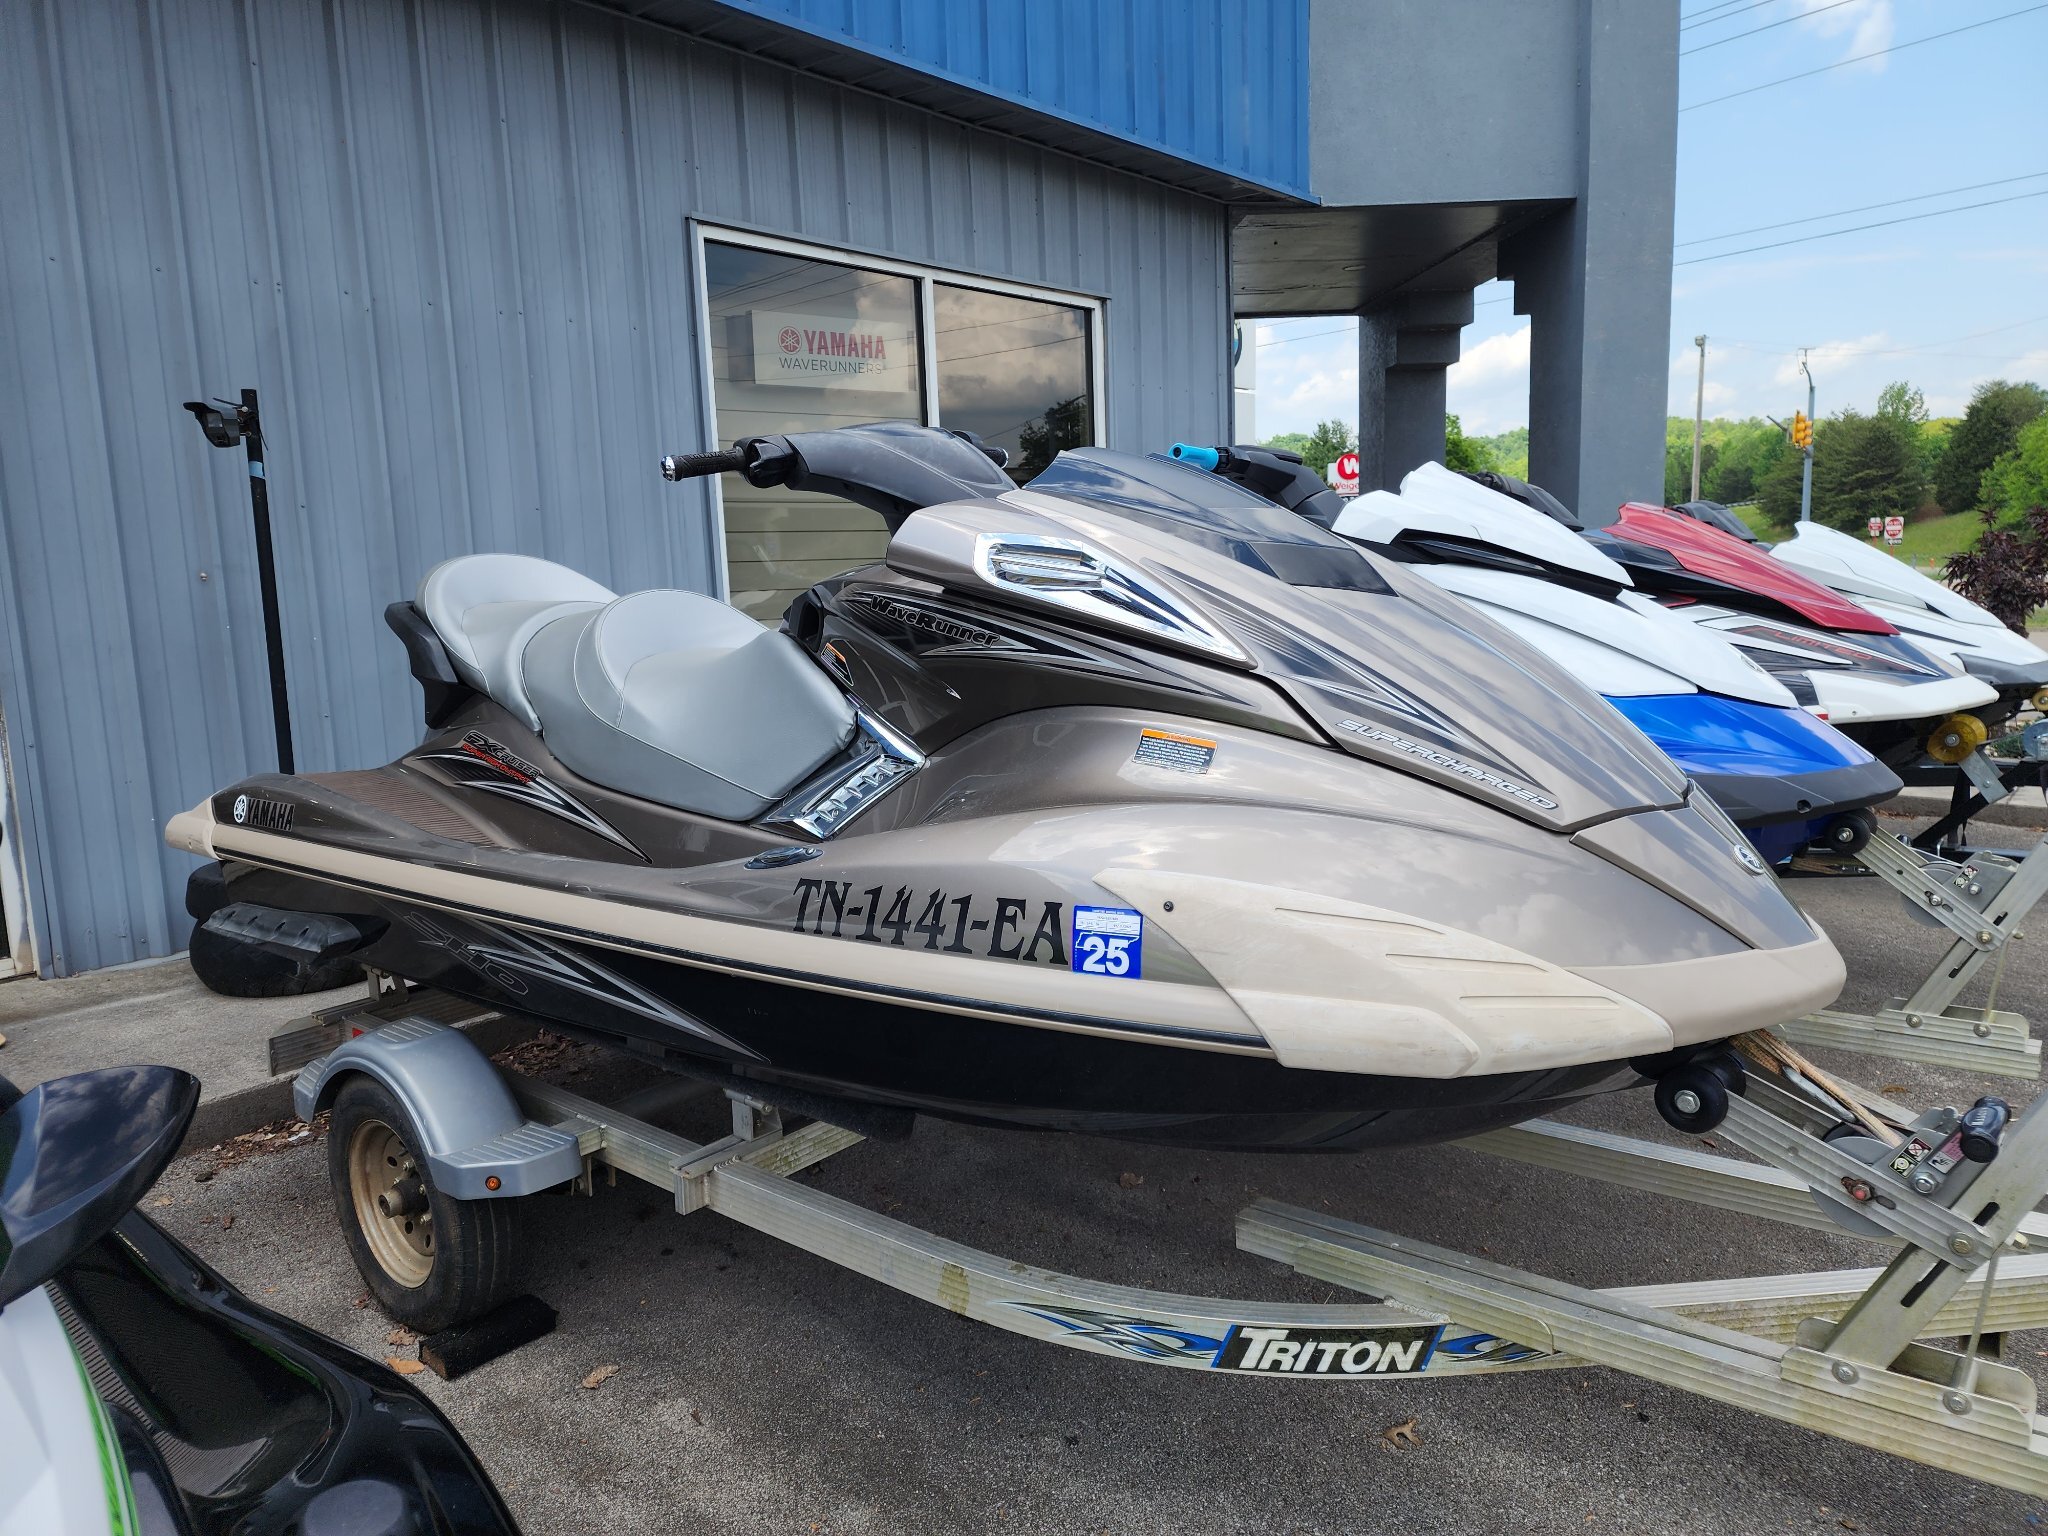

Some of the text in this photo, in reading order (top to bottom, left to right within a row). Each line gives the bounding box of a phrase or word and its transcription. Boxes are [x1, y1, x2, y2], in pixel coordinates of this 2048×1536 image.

[778, 356, 883, 375] WAVERUNNERS
[803, 329, 887, 360] YAMAHA
[870, 594, 1001, 648] WaveRunner
[464, 731, 540, 780] FX CRUISER
[1335, 718, 1559, 810] SUPERCHARGED
[246, 797, 296, 832] YAMAHA
[793, 877, 1069, 965] TN-1441-EA
[402, 911, 529, 986] SHO
[1082, 936, 1130, 975] 25
